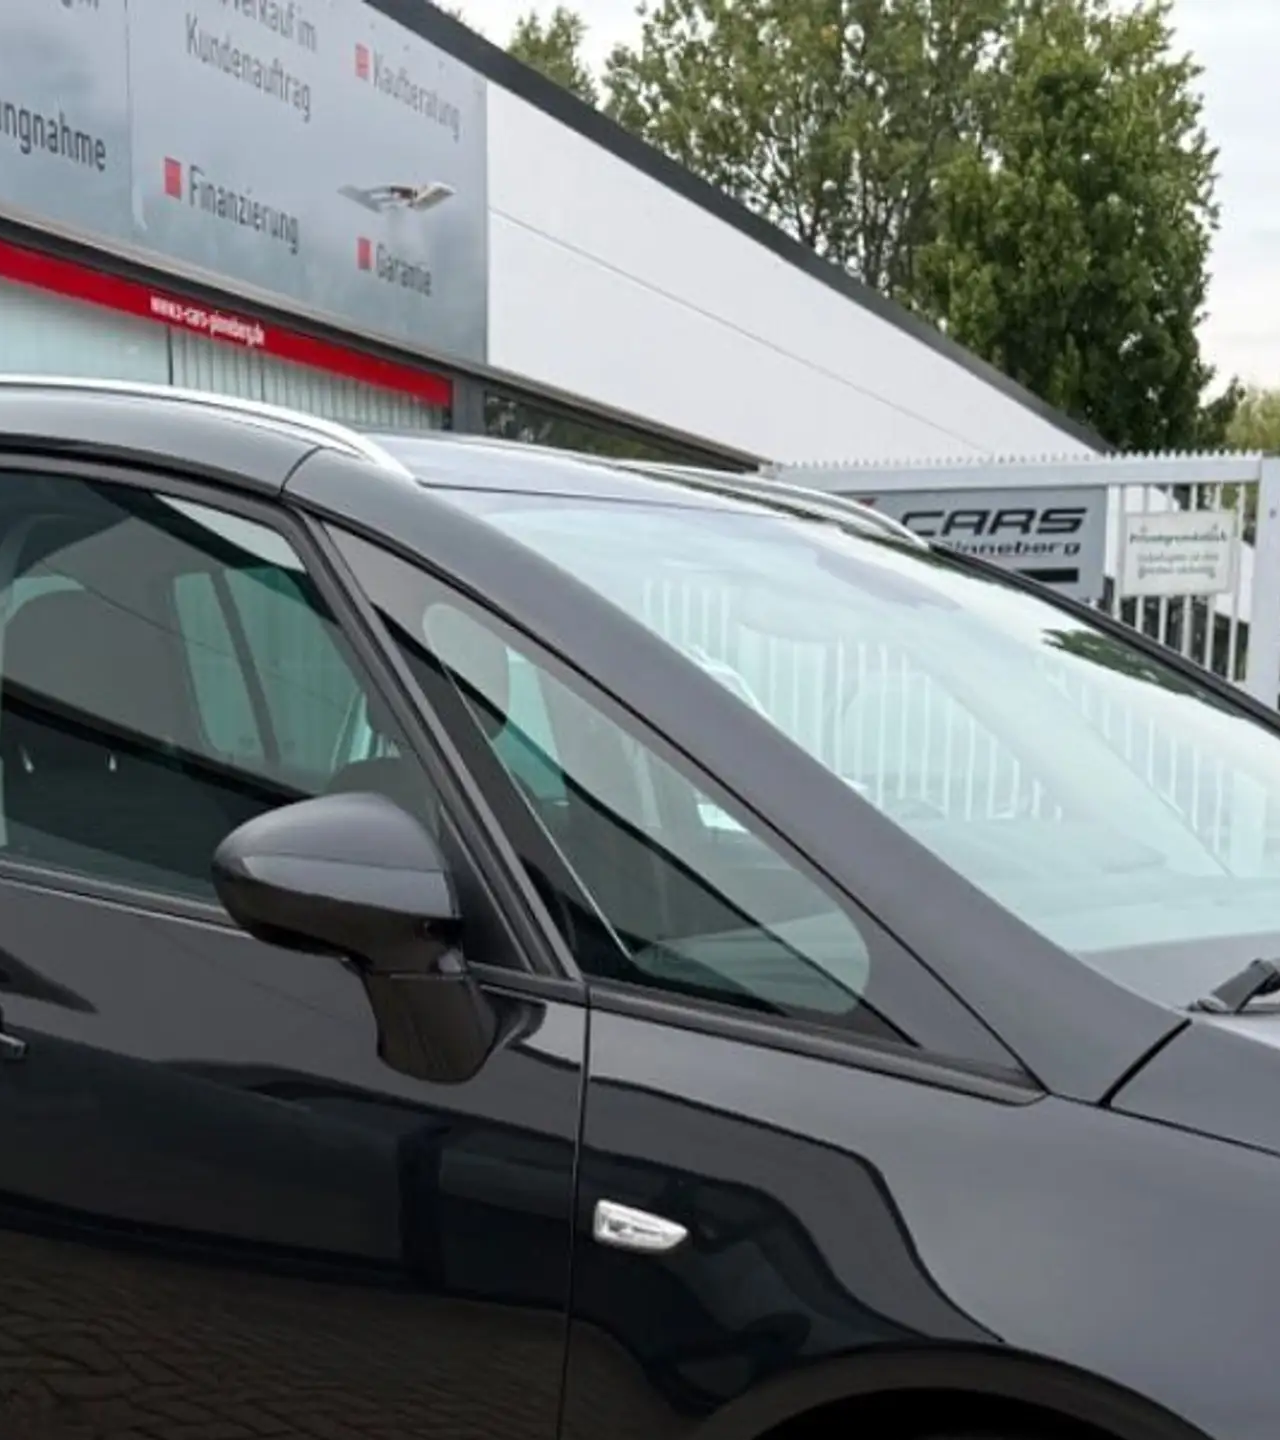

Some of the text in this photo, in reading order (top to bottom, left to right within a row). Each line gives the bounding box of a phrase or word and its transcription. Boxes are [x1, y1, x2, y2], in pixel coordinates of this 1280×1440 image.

[186, 12, 312, 123] Kundenauftrag
[373, 50, 461, 142] Kaufberatung
[189, 165, 300, 255] Finanzierung
[376, 243, 432, 296] Garantie
[902, 507, 1086, 537] CARS
